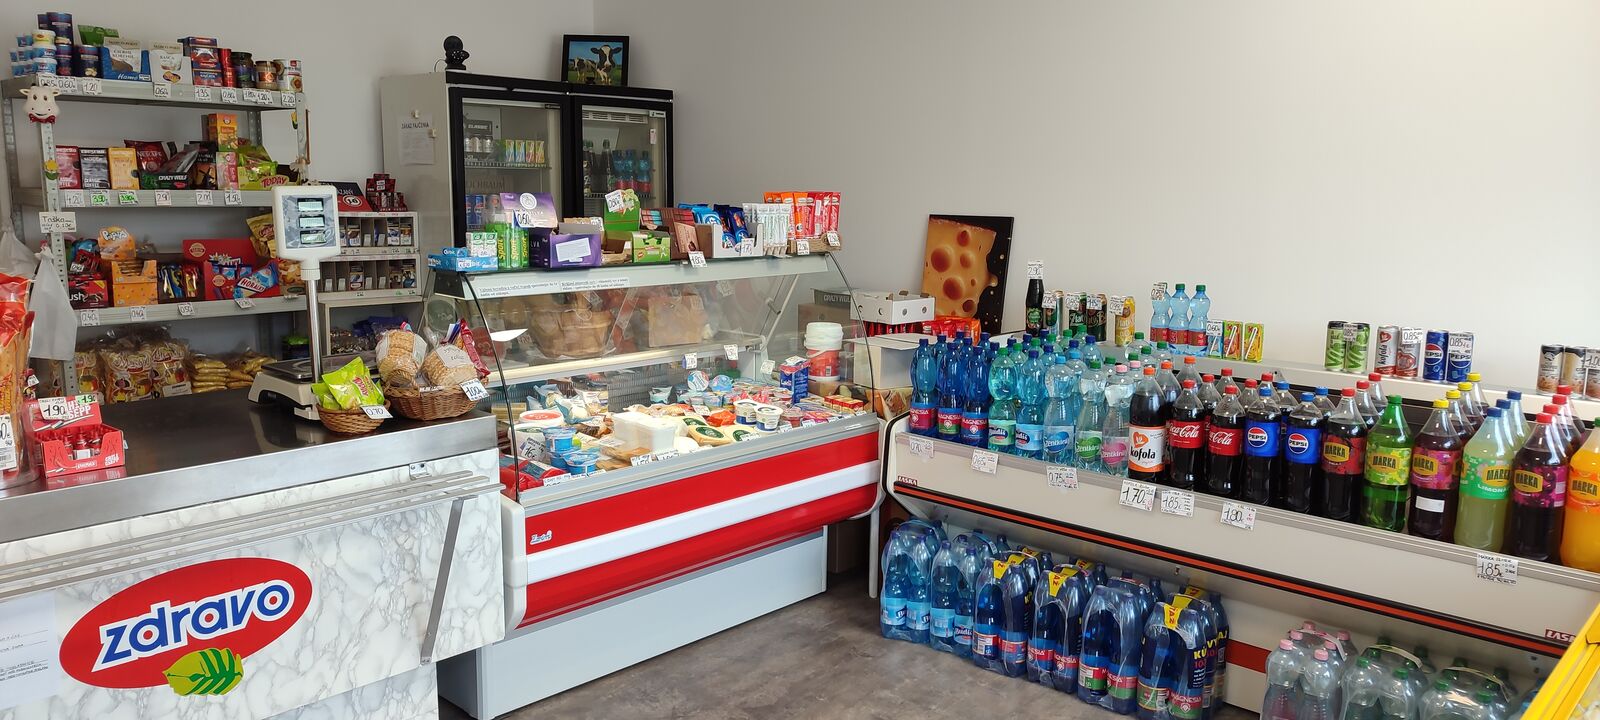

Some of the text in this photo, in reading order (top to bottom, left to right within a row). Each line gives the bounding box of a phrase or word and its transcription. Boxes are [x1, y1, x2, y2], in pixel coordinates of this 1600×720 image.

[261, 175, 288, 188] TODAY
[42, 215, 65, 224] Taška
[1247, 433, 1268, 442] PEPSI
[1288, 439, 1309, 448] PEPSI
[1129, 448, 1156, 461] kofola
[1372, 454, 1397, 469] MARKA
[1515, 472, 1539, 489] MARKA
[1571, 479, 1598, 496] MARKA
[99, 583, 292, 667] zdravo
